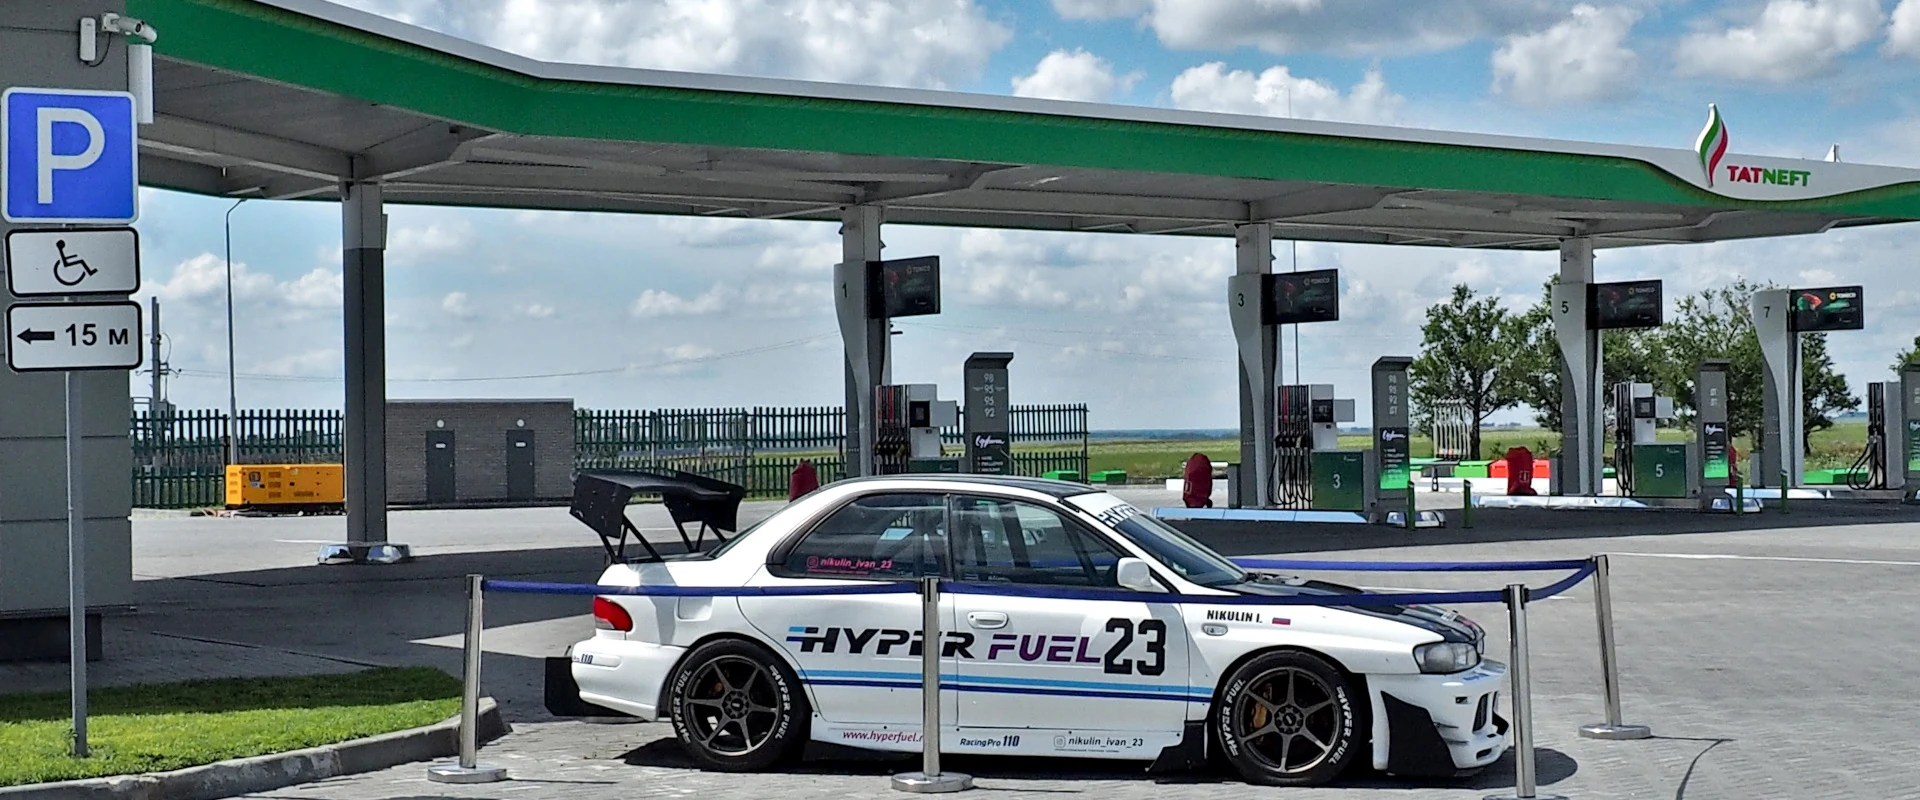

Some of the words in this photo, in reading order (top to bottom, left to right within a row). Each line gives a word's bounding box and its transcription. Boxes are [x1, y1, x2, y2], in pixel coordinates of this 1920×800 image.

[37, 107, 105, 204] P
[1727, 165, 1811, 186] TATNEFT
[842, 282, 848, 298] 1
[1237, 292, 1245, 307] 3
[1561, 300, 1569, 314] 5
[1763, 305, 1771, 318] 7
[65, 323, 97, 346] 15
[983, 384, 994, 394] 95
[984, 396, 995, 406] 95
[984, 408, 995, 418] 92
[1655, 463, 1664, 478] 5
[1333, 473, 1341, 489] 3
[820, 557, 893, 570] nikulin_ivan_23
[1206, 609, 1253, 623] NIKULIN
[987, 633, 1101, 663] FUEL
[1103, 617, 1167, 677] 23
[769, 664, 791, 711] HYPER
[1225, 679, 1247, 704] FUEL
[1336, 685, 1353, 737] HYPER
[774, 713, 790, 739] FUEL
[1222, 706, 1239, 757] HYPER
[843, 730, 923, 744] www.hyperfuel.r
[1002, 735, 1020, 747] 110
[1068, 737, 1144, 749] nikulin_ivan_23
[1327, 739, 1349, 764] FUEL
